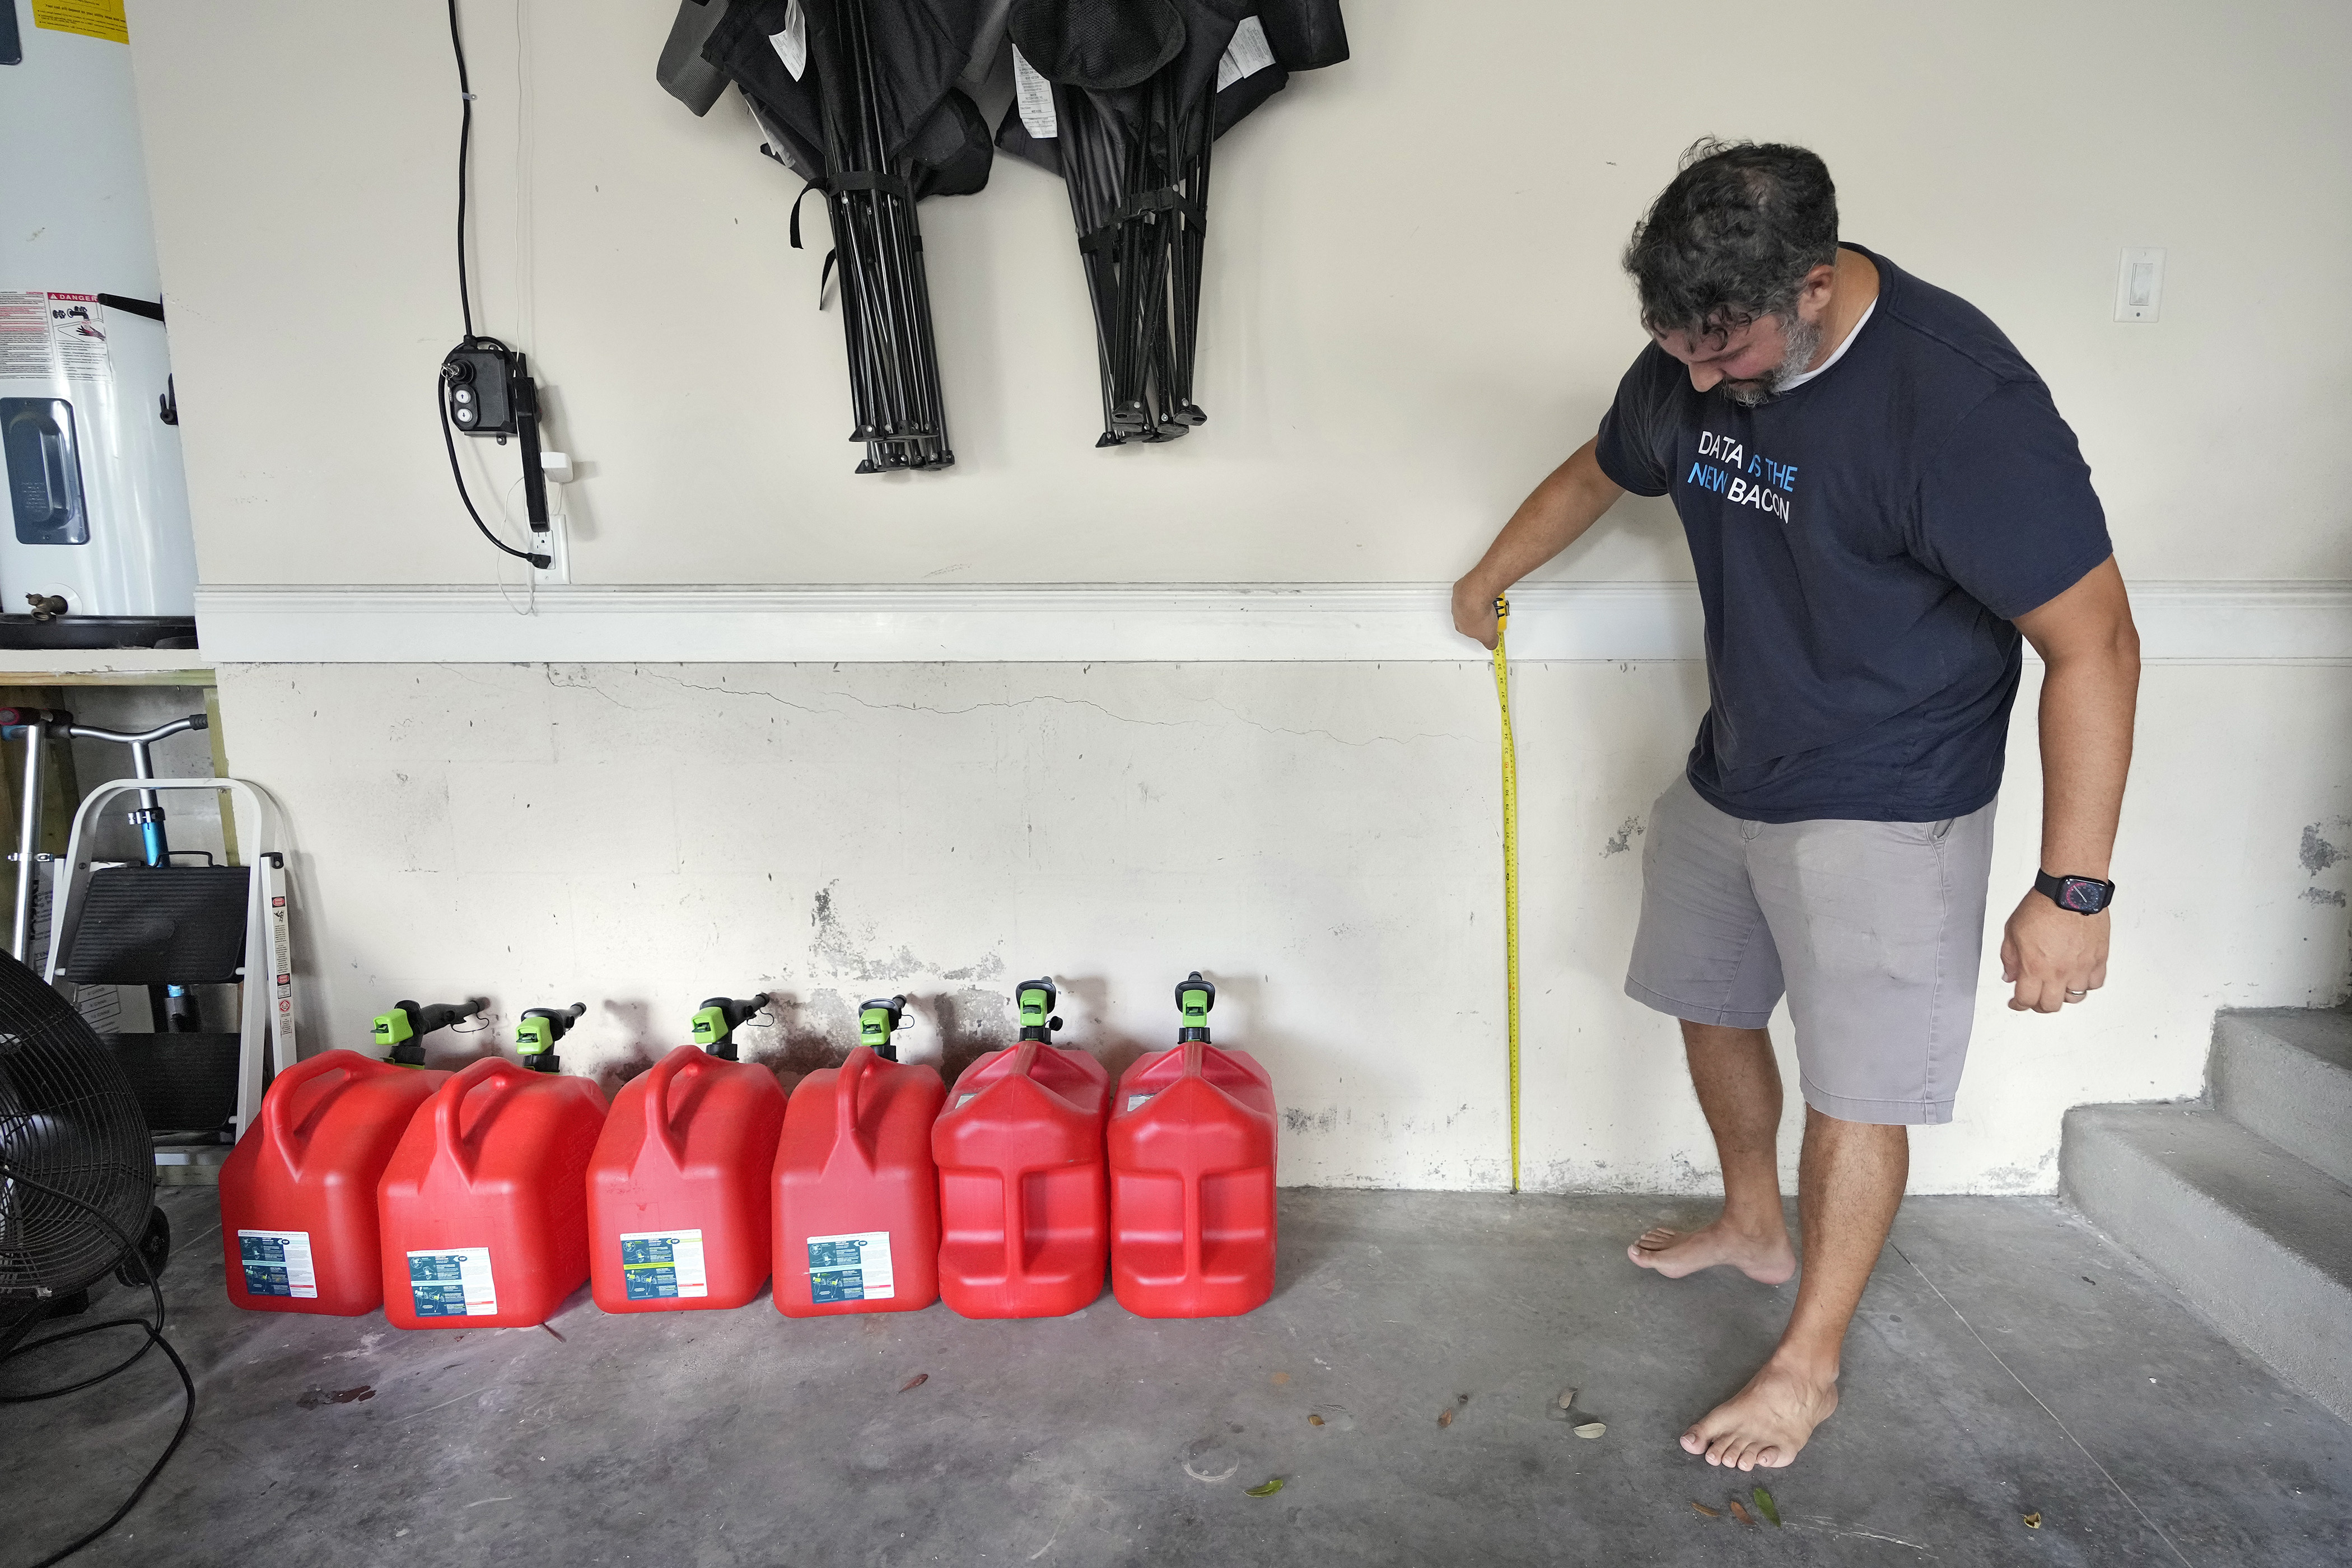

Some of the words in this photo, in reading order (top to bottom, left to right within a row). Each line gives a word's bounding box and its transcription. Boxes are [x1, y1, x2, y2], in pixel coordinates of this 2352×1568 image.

[1698, 431, 1743, 469] DATA
[1747, 454, 1761, 477] IS
[1765, 458, 1798, 492] THE
[1687, 462, 1728, 493] NEW
[1726, 477, 1790, 524] BACON
